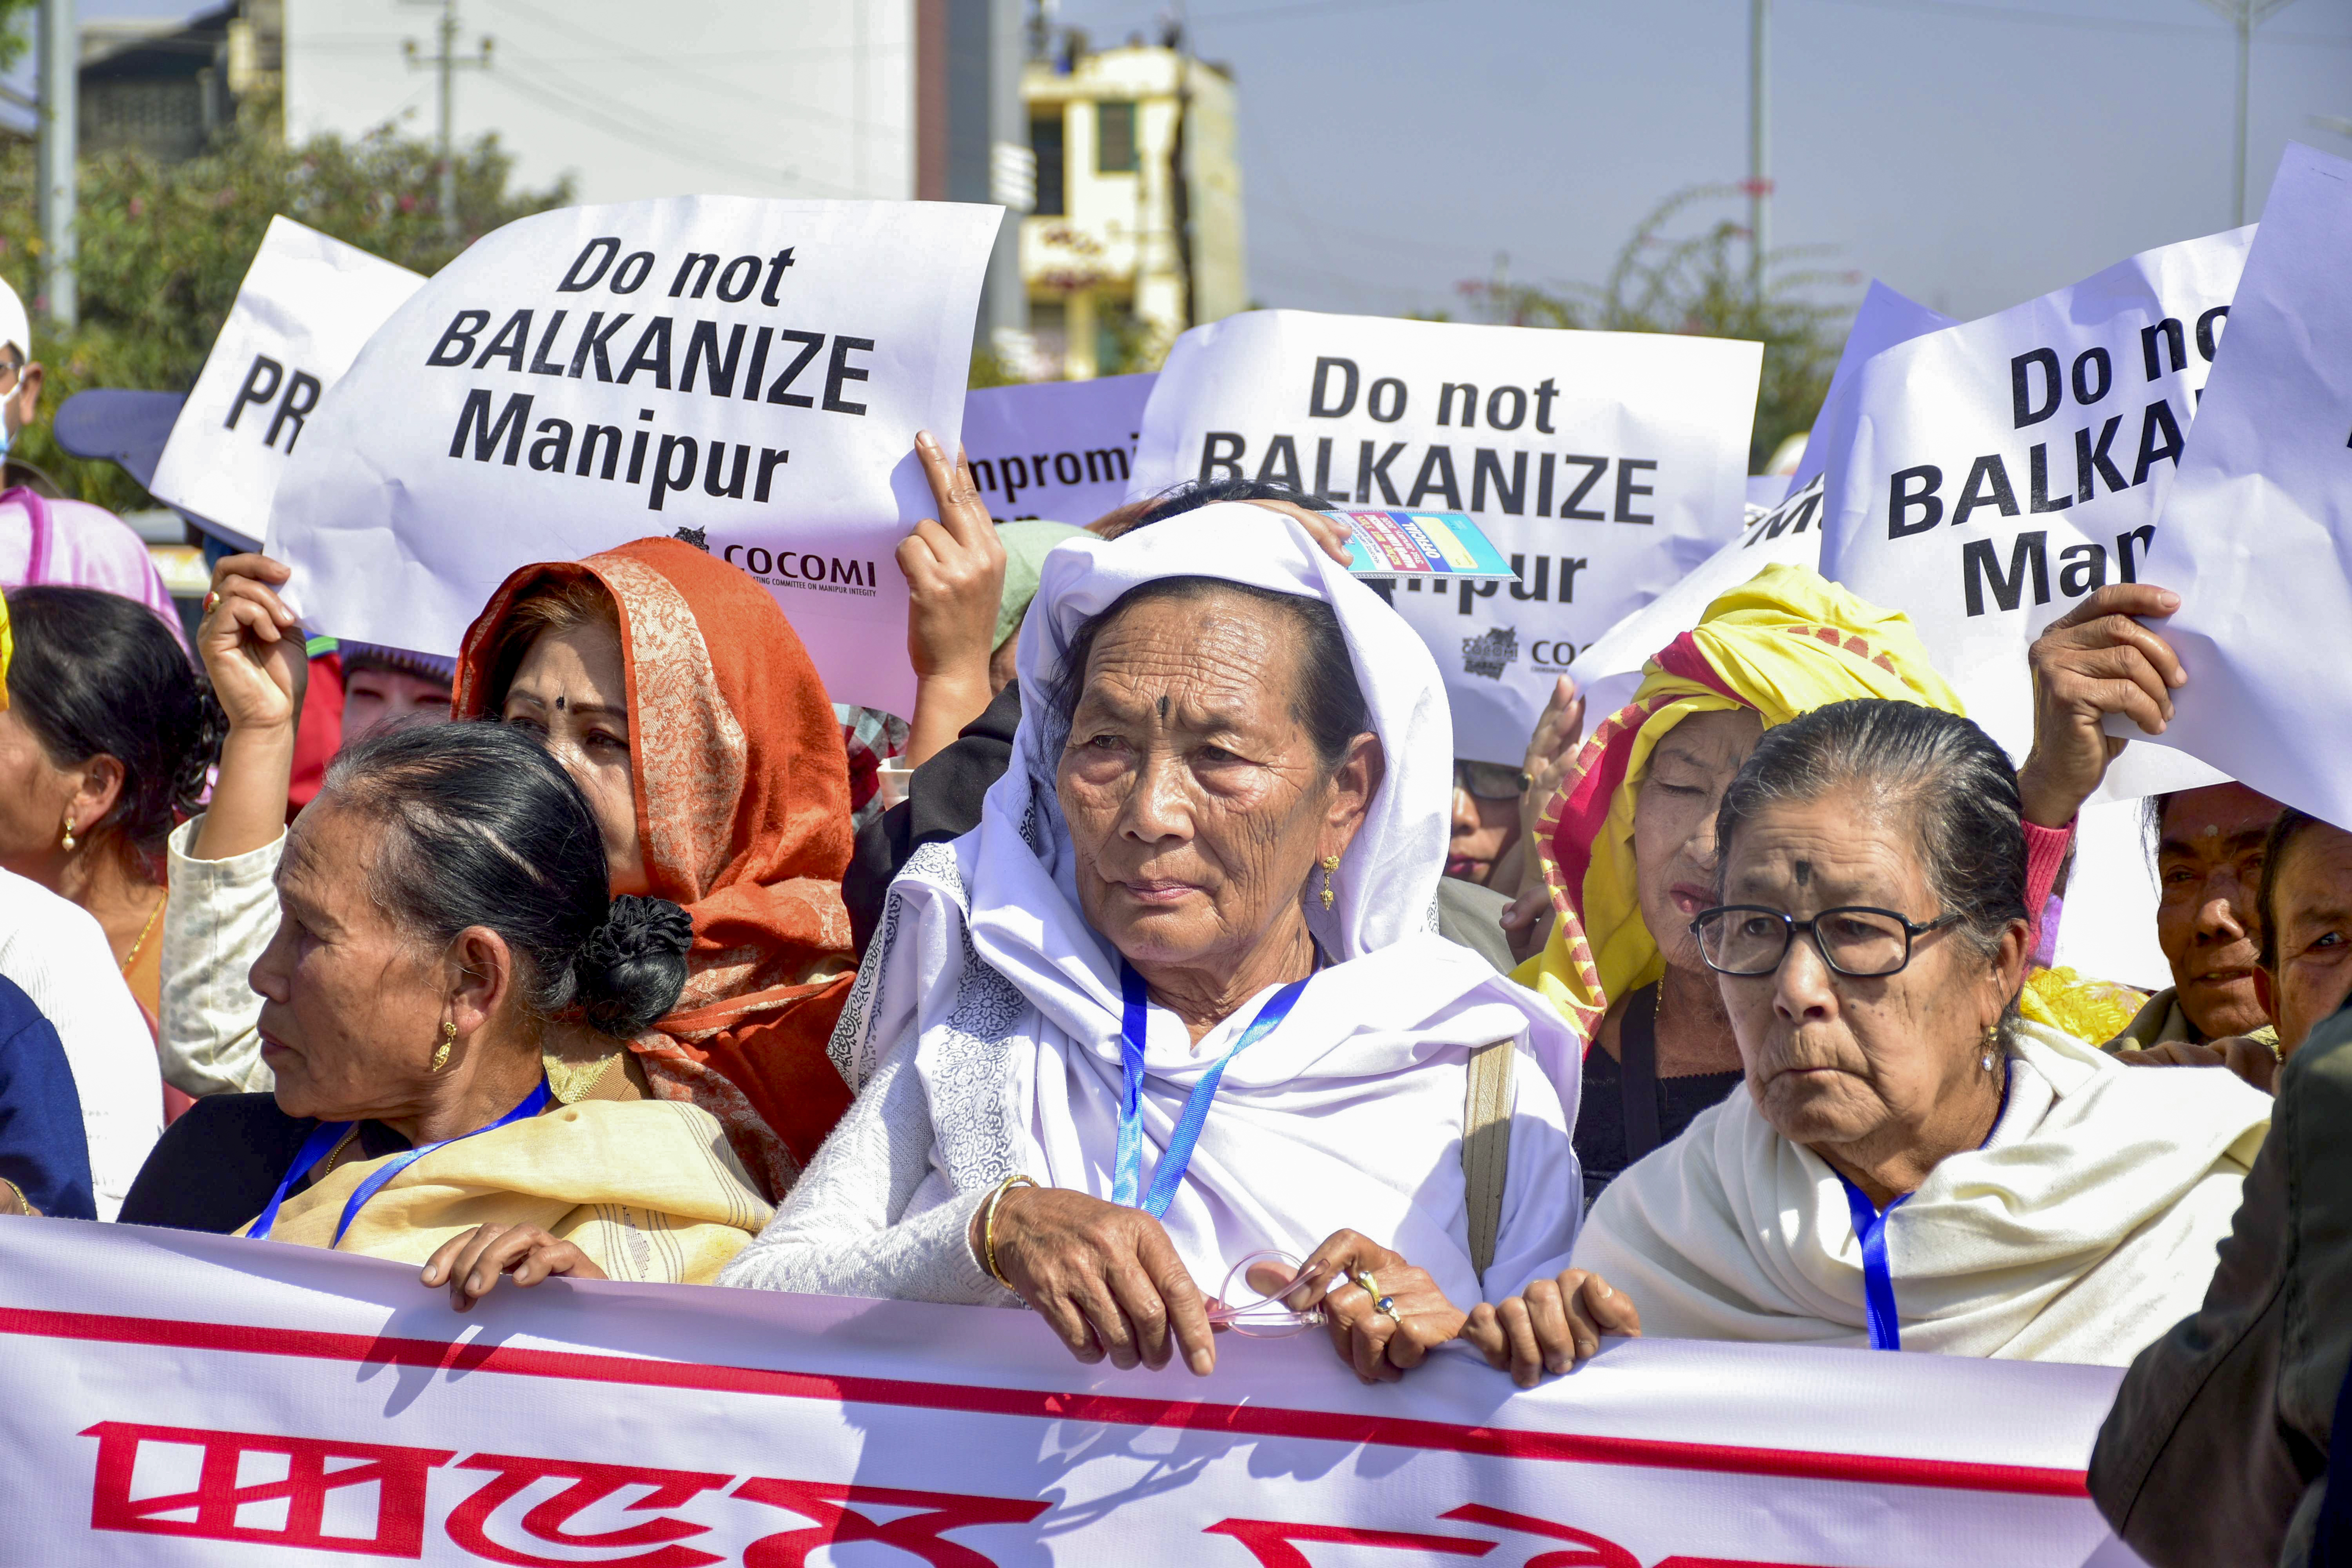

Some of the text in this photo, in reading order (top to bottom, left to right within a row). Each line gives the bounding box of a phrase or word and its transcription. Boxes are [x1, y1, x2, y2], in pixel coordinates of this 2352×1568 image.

[556, 237, 795, 306] Do not
[425, 309, 875, 416] BALKANIZE
[1309, 356, 1560, 433] Do not
[2010, 347, 2112, 429] Do
[223, 353, 321, 456] PR
[448, 389, 789, 511] Manipur
[1198, 431, 1657, 525] BALKANIZE
[1888, 389, 2204, 539] BALKA
[724, 545, 876, 588] COCOMI
[1402, 522, 1441, 558] OFFICIAL
[1410, 552, 1424, 564] 31st
[772, 579, 806, 589] COMMITTEE
[819, 584, 847, 594] MANIPUR
[849, 588, 876, 597] INTEGITY
[1532, 640, 1593, 666] CO
